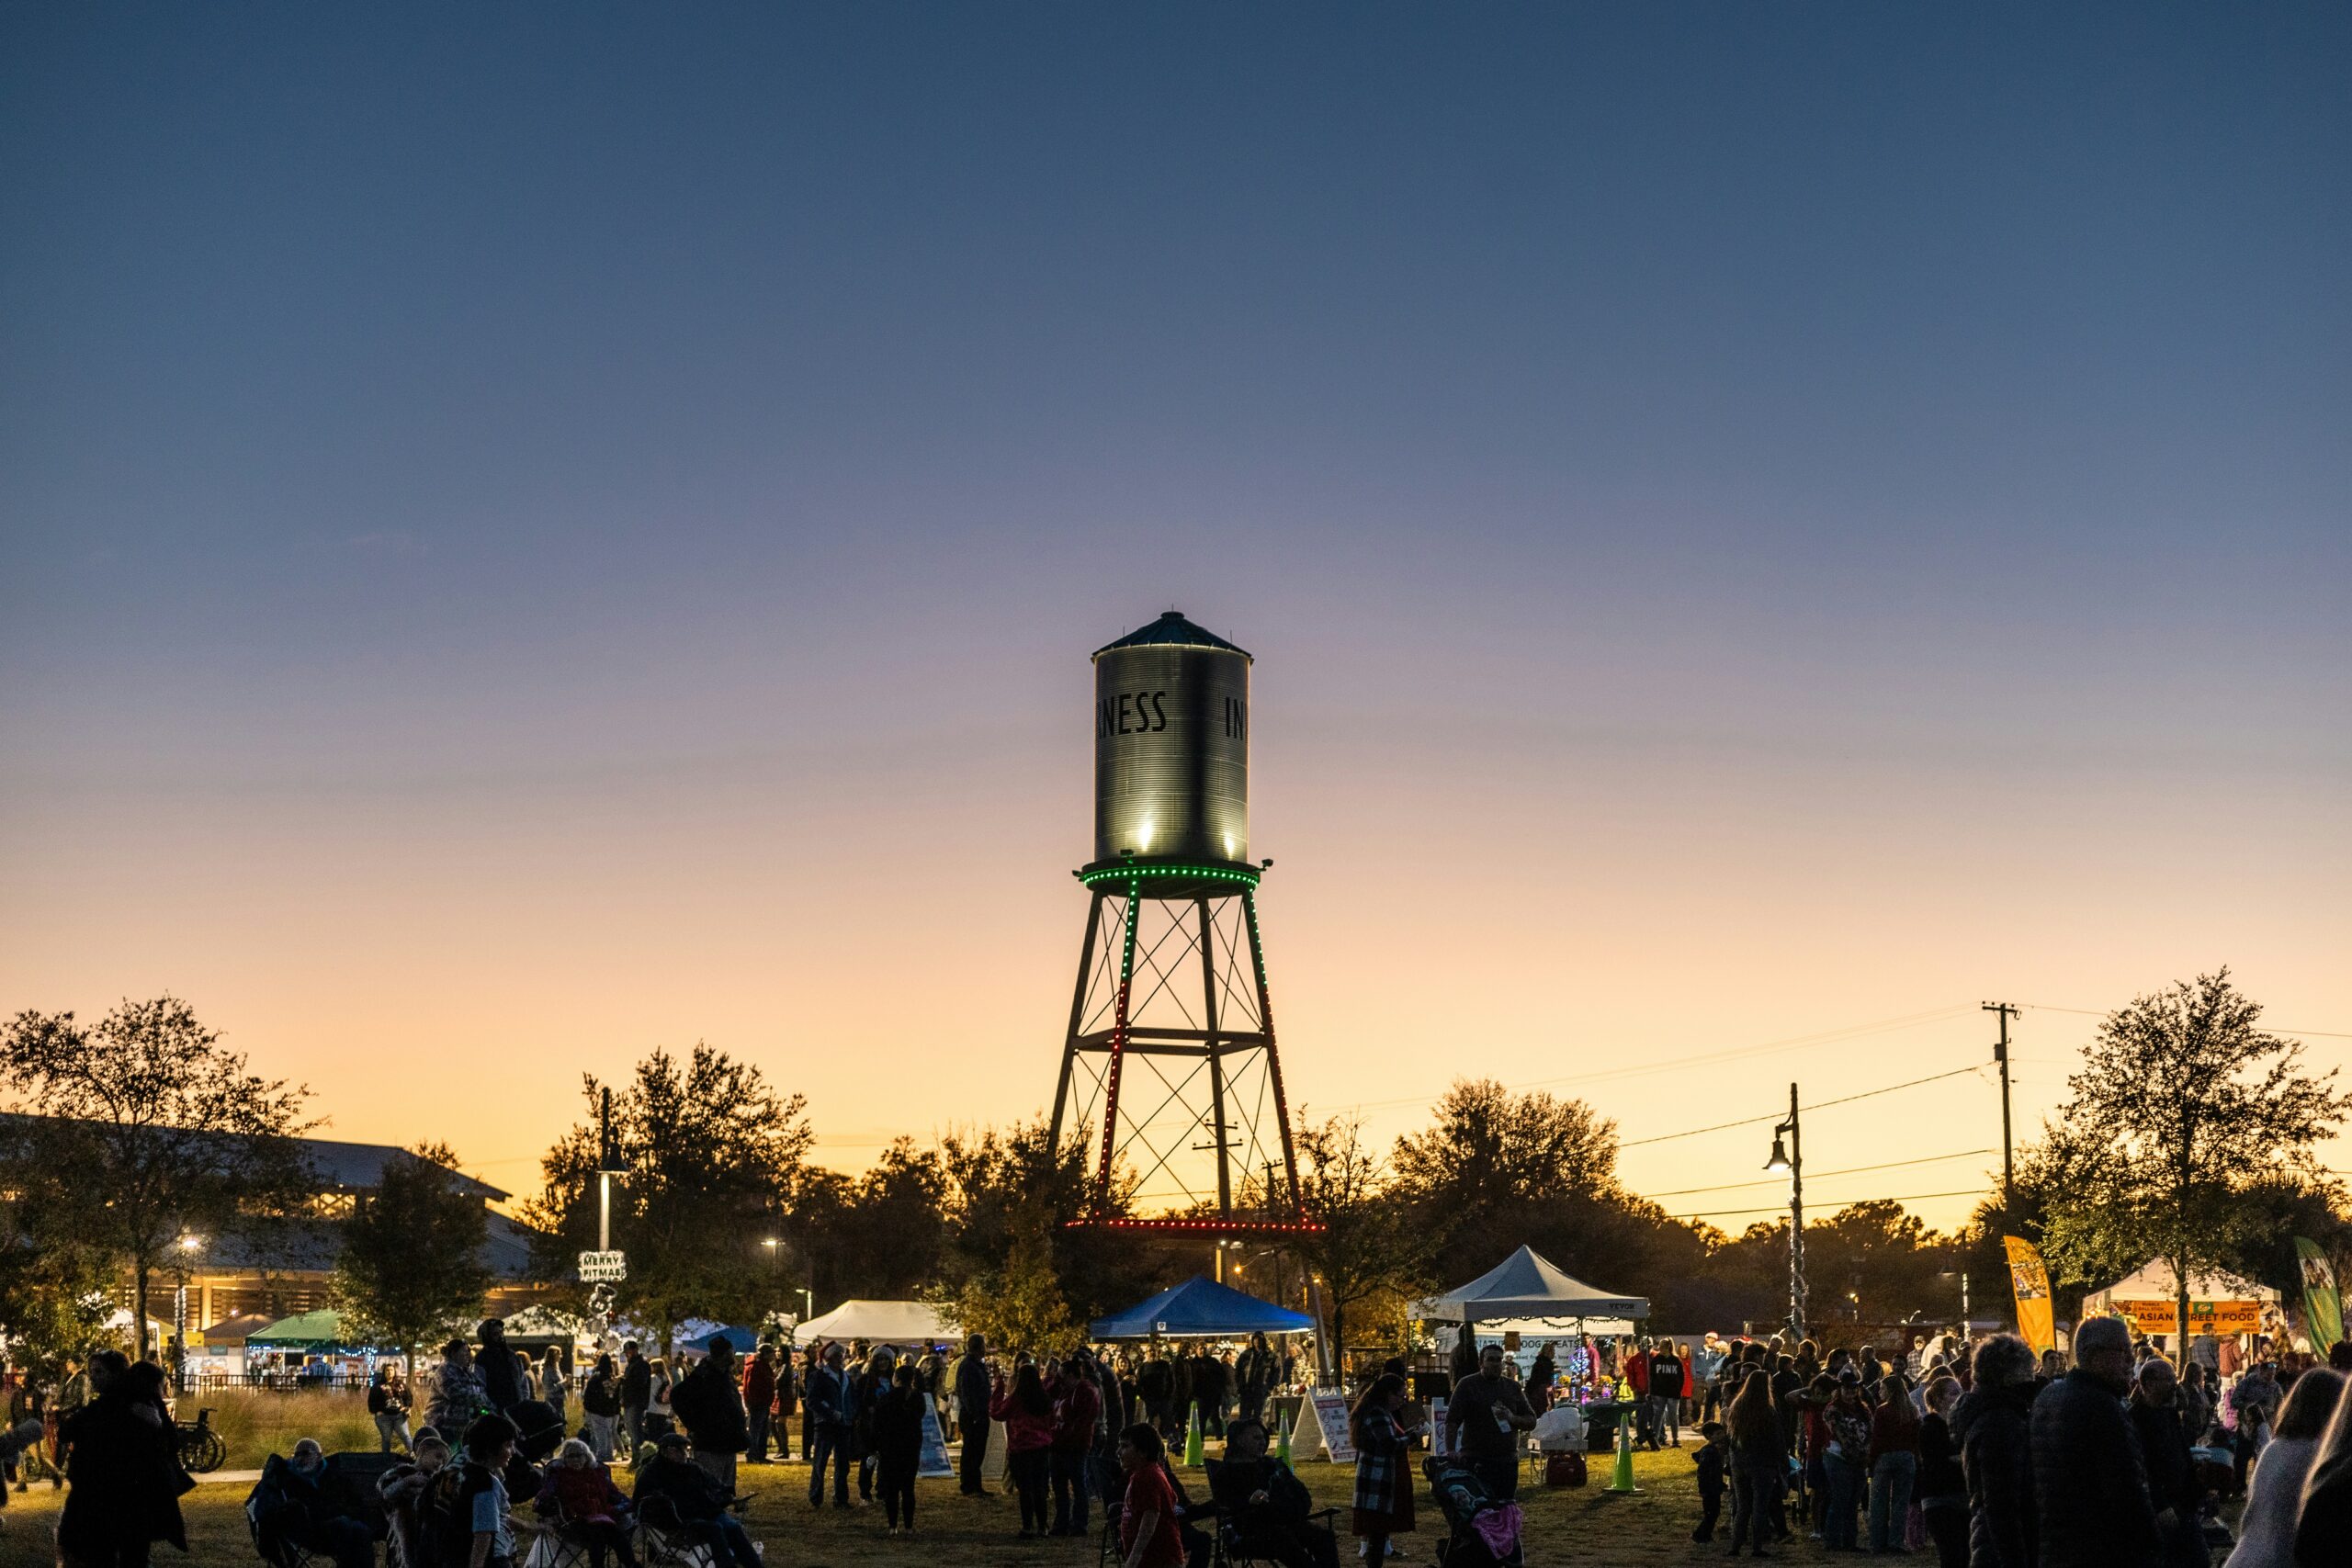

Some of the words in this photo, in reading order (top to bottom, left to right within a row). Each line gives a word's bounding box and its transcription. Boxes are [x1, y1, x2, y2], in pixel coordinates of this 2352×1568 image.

[583, 1255, 619, 1266] MERRY
[2139, 1313, 2174, 1321] ASIAN
[2188, 1313, 2219, 1321] REET
[2222, 1313, 2256, 1321] FOOD
[1521, 1340, 1541, 1348] DOG
[1544, 1339, 1578, 1348] TEATS
[1656, 1364, 1678, 1374] PINK
